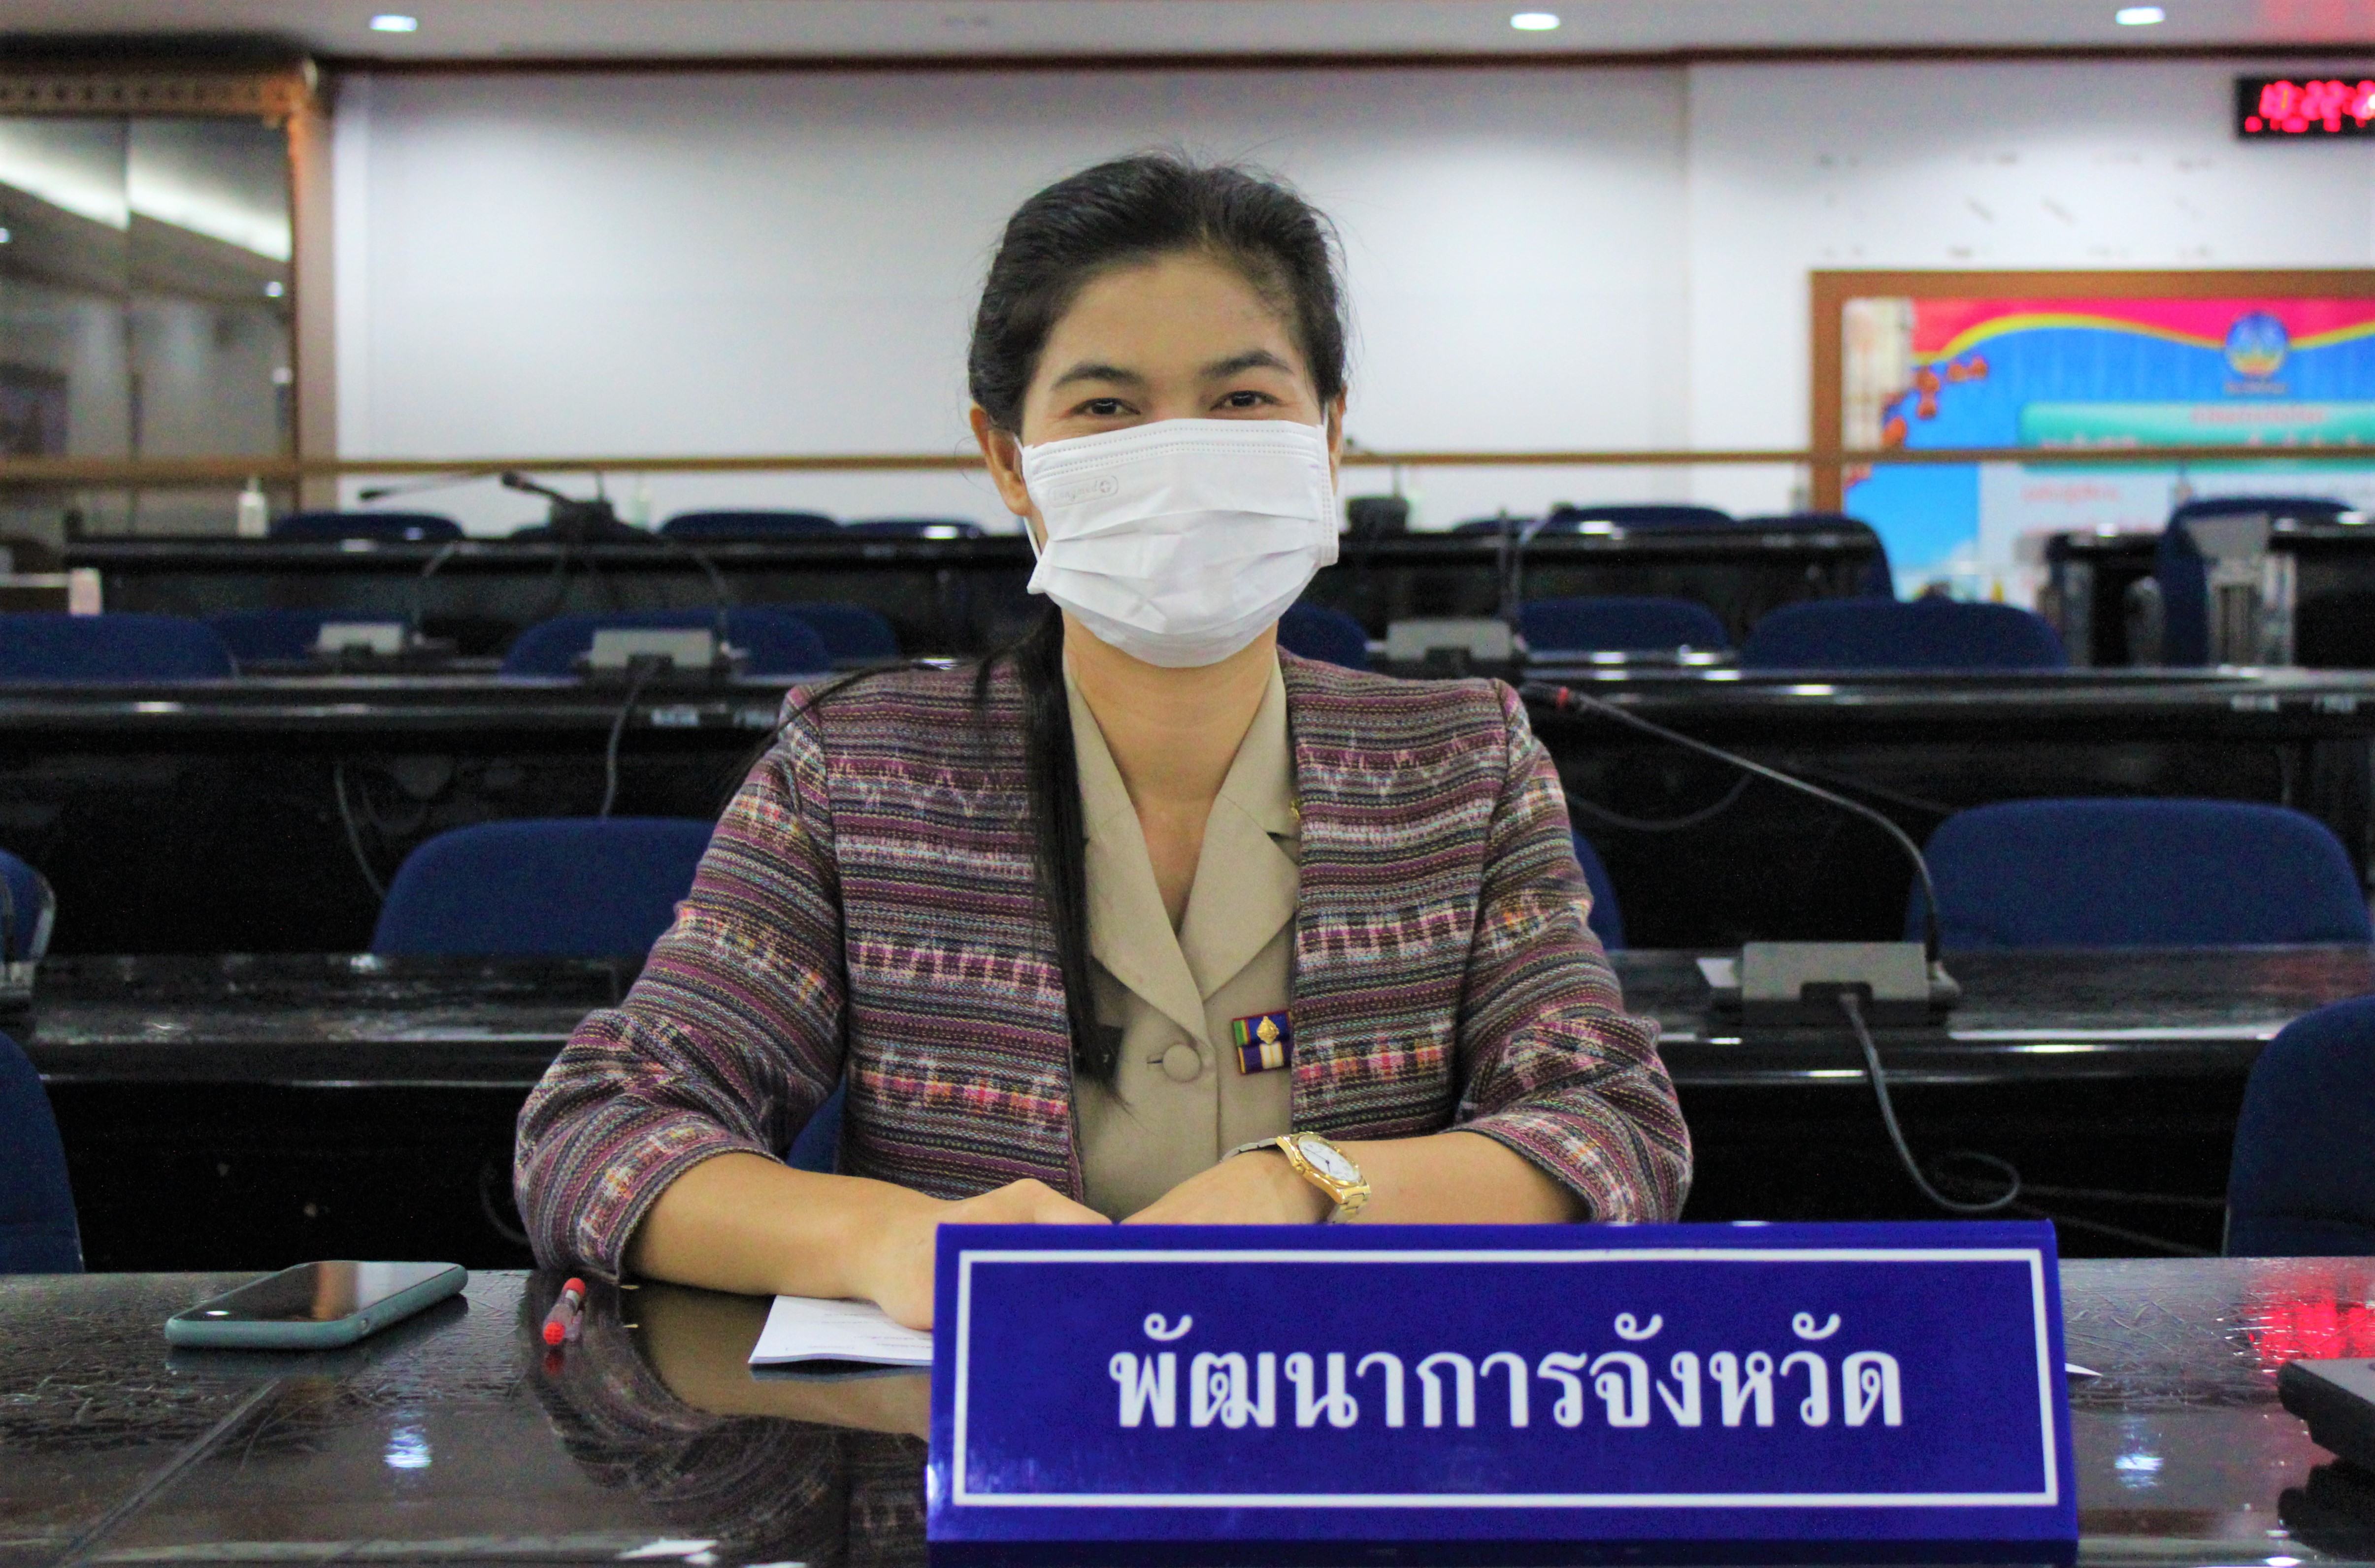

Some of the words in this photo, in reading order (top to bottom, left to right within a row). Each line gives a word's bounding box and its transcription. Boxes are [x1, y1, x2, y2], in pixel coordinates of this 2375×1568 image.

[1109, 1312, 1902, 1428] พัฒนาการจังหวัด
